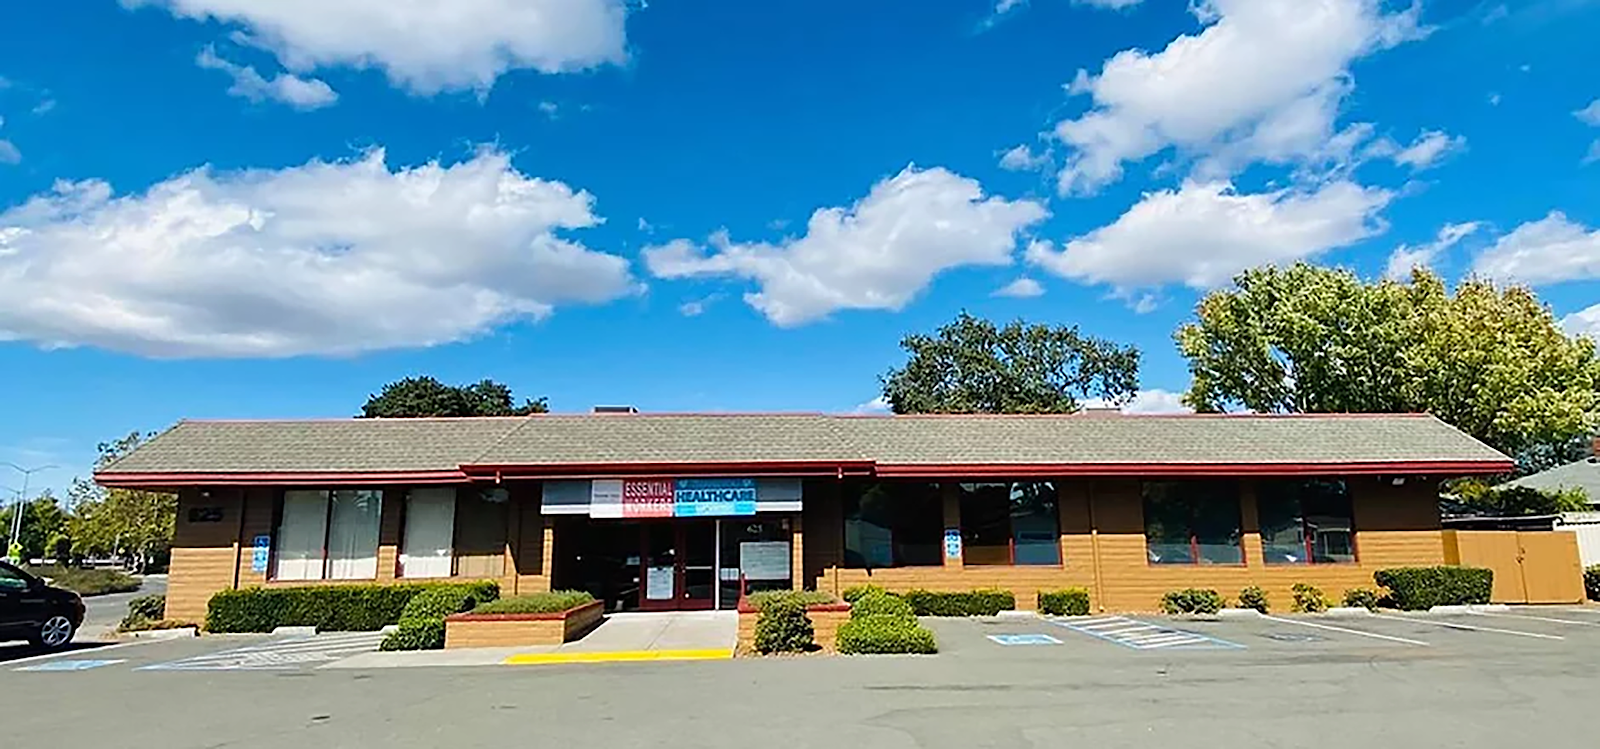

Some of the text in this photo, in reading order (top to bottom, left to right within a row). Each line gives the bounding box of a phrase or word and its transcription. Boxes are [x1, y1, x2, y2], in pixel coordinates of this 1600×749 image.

[625, 482, 673, 497] ESSENTIAL
[676, 489, 755, 503] HEALTHCARE
[625, 497, 673, 512] WORKERS
